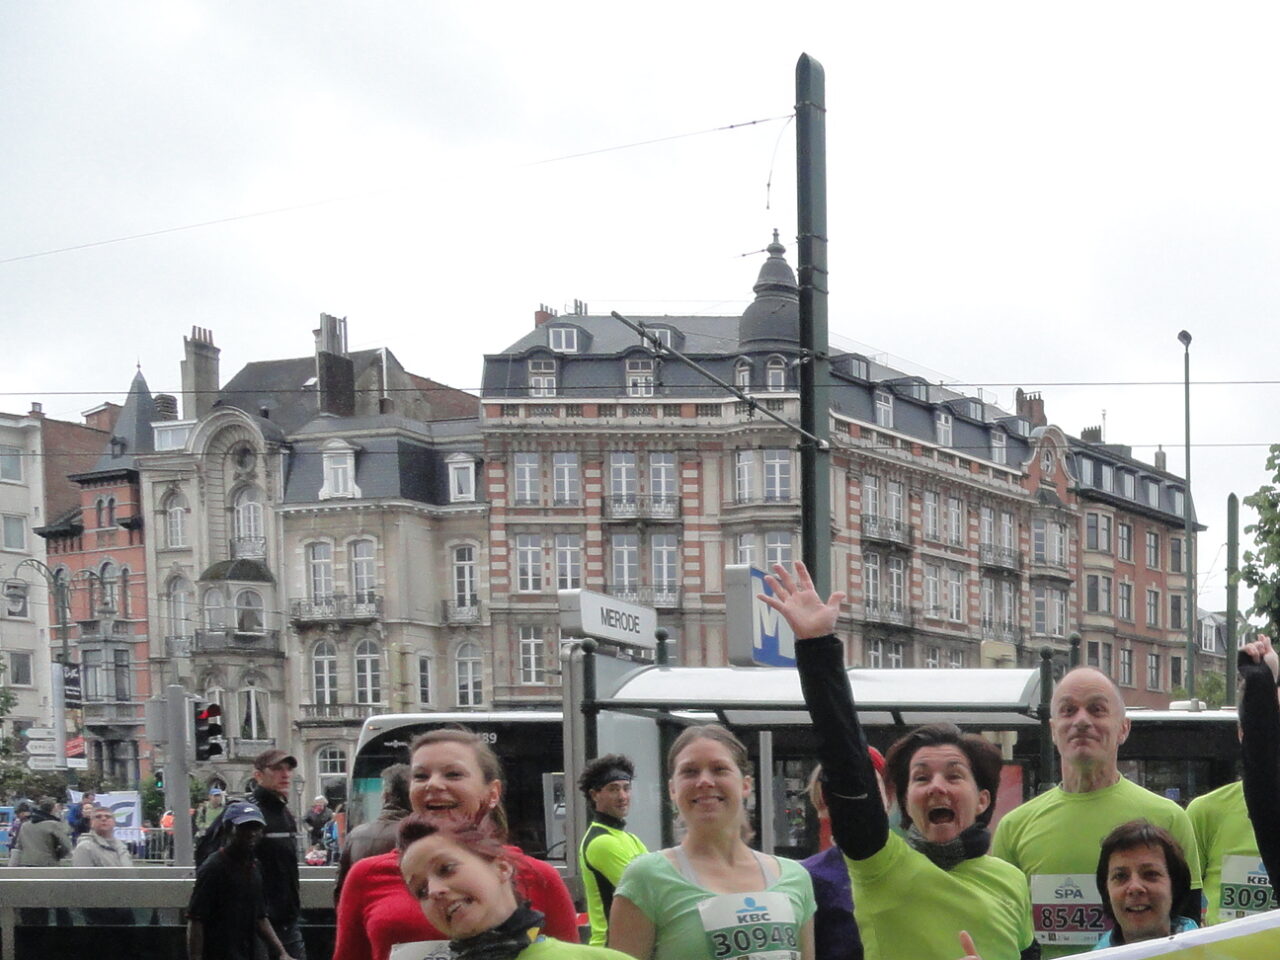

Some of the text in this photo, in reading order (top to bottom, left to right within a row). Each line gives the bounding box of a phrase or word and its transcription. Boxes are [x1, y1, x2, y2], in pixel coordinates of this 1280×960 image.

[600, 606, 640, 634] MERODE
[751, 575, 796, 661] M
[1247, 876, 1272, 885] KB
[1054, 888, 1083, 899] SPA
[737, 912, 771, 924] KBC
[1041, 907, 1104, 928] 8542
[713, 926, 797, 957] 30948
